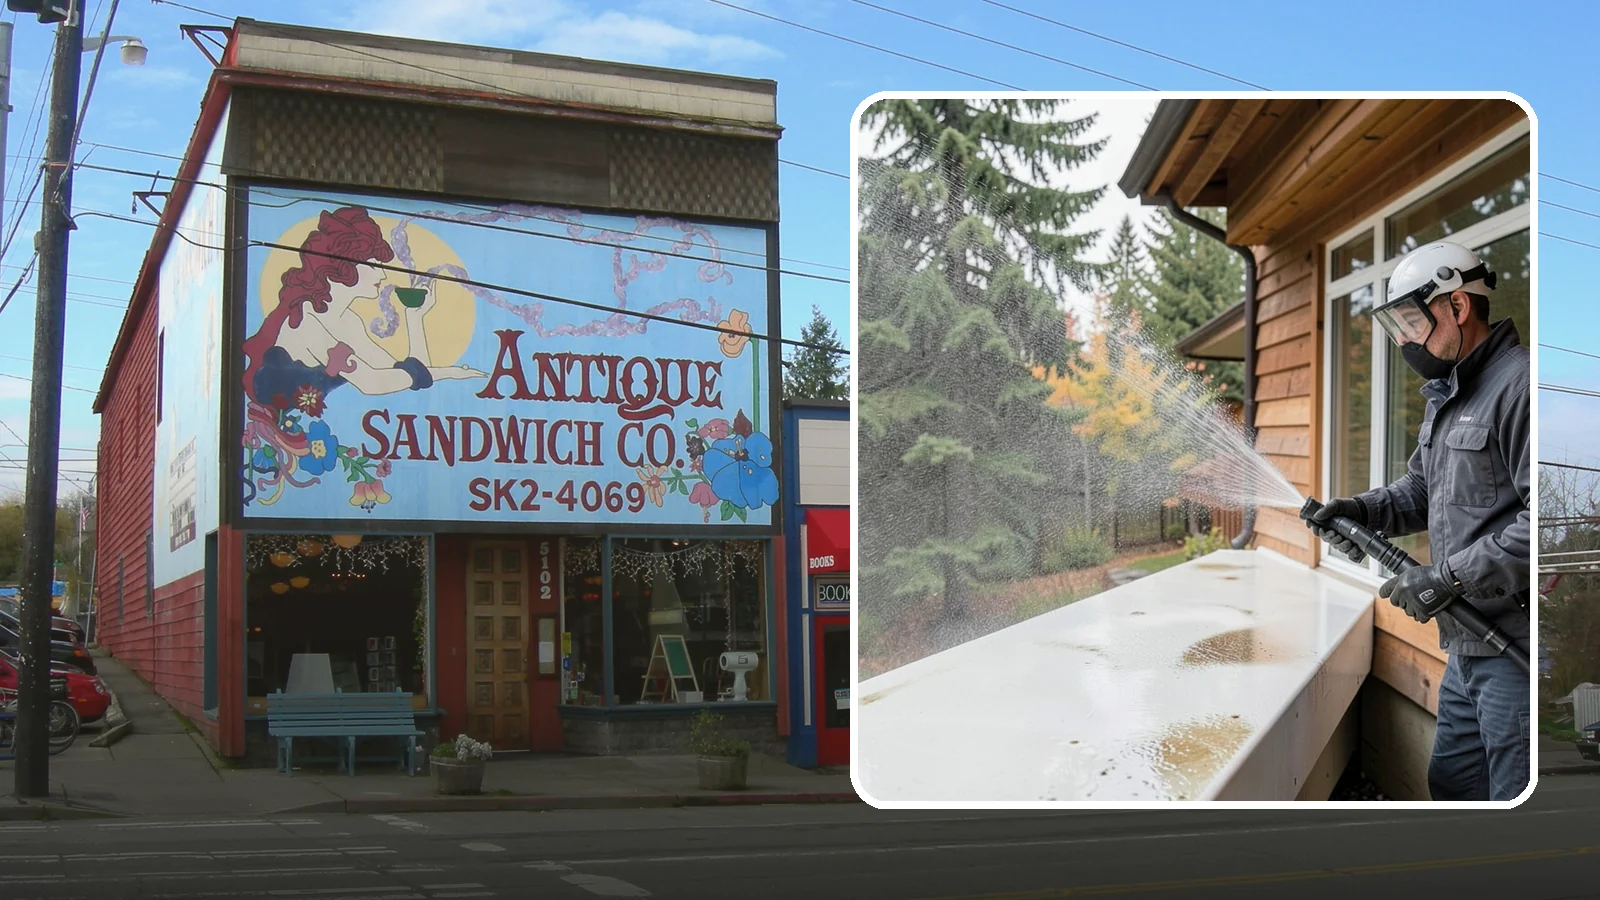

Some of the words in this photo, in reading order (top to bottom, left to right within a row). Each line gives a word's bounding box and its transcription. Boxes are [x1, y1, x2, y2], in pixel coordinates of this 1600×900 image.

[475, 328, 724, 421] ANTIQUE
[361, 408, 605, 467] SANDWICH
[617, 421, 685, 468] CO.
[468, 477, 646, 514] SK2-4069
[539, 541, 552, 600] 5102
[809, 555, 835, 569] BOOKS
